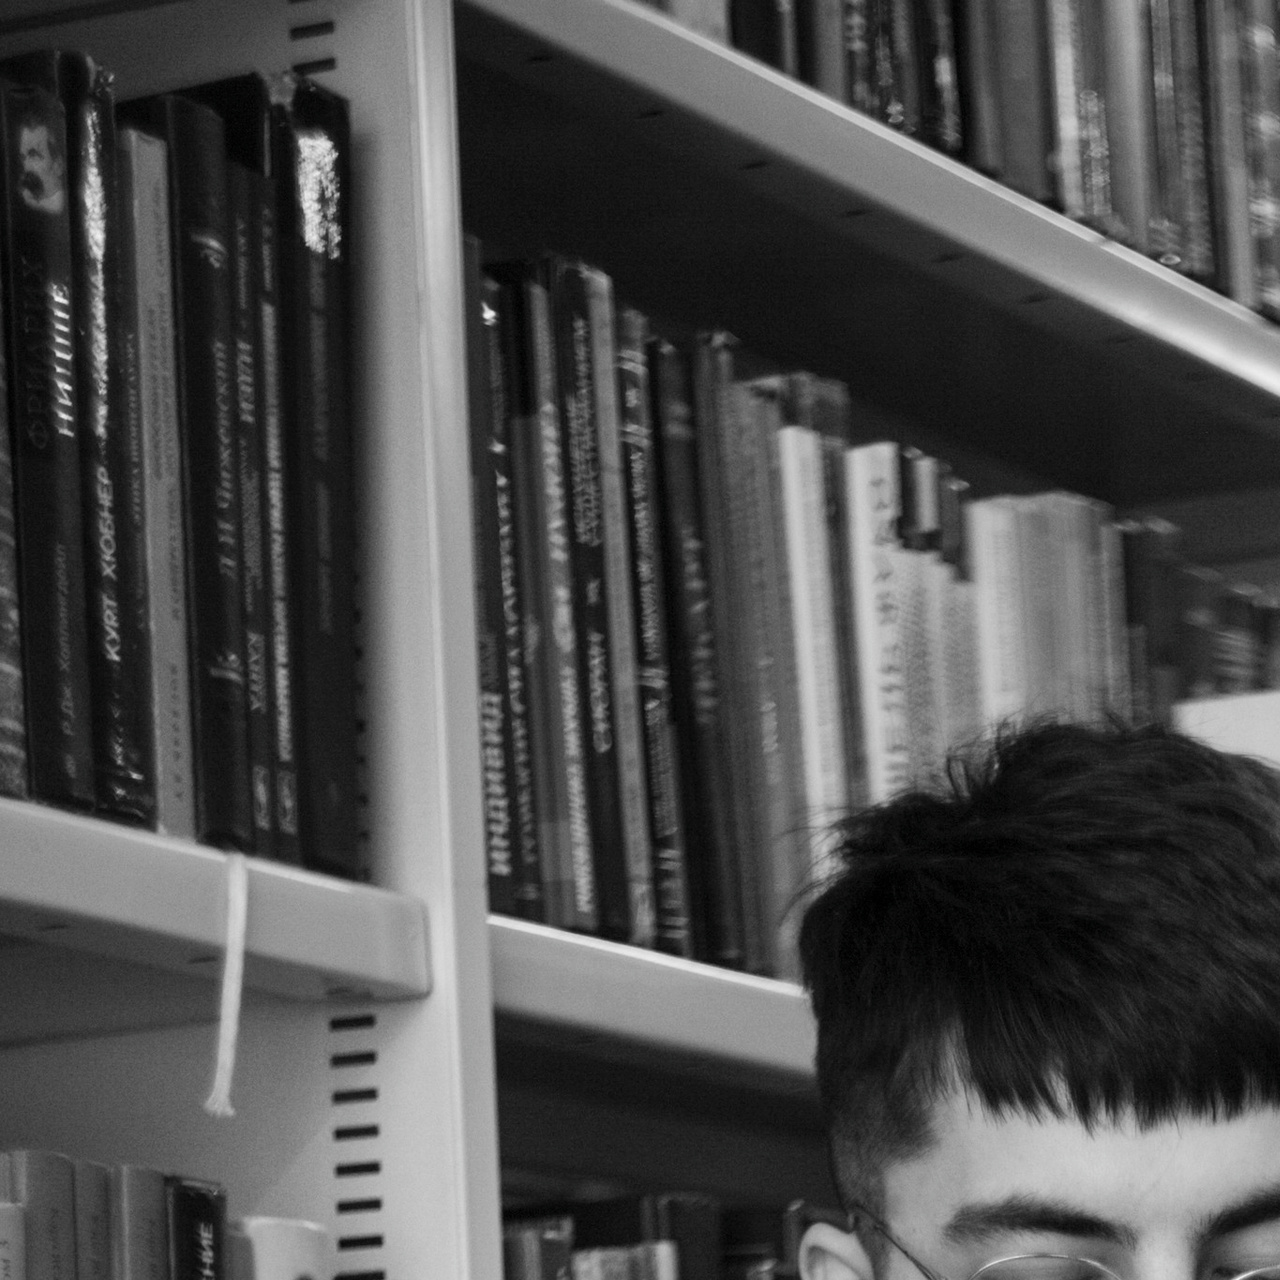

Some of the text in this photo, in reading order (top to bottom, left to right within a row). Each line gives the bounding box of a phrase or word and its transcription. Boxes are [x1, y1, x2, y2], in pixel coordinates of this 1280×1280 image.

[48, 282, 75, 438] НИЦШЕ
[211, 340, 232, 509] Чижевский
[94, 466, 121, 663] КУРТ ХЮБНЕР
[481, 692, 511, 875] ИНДИВИД
